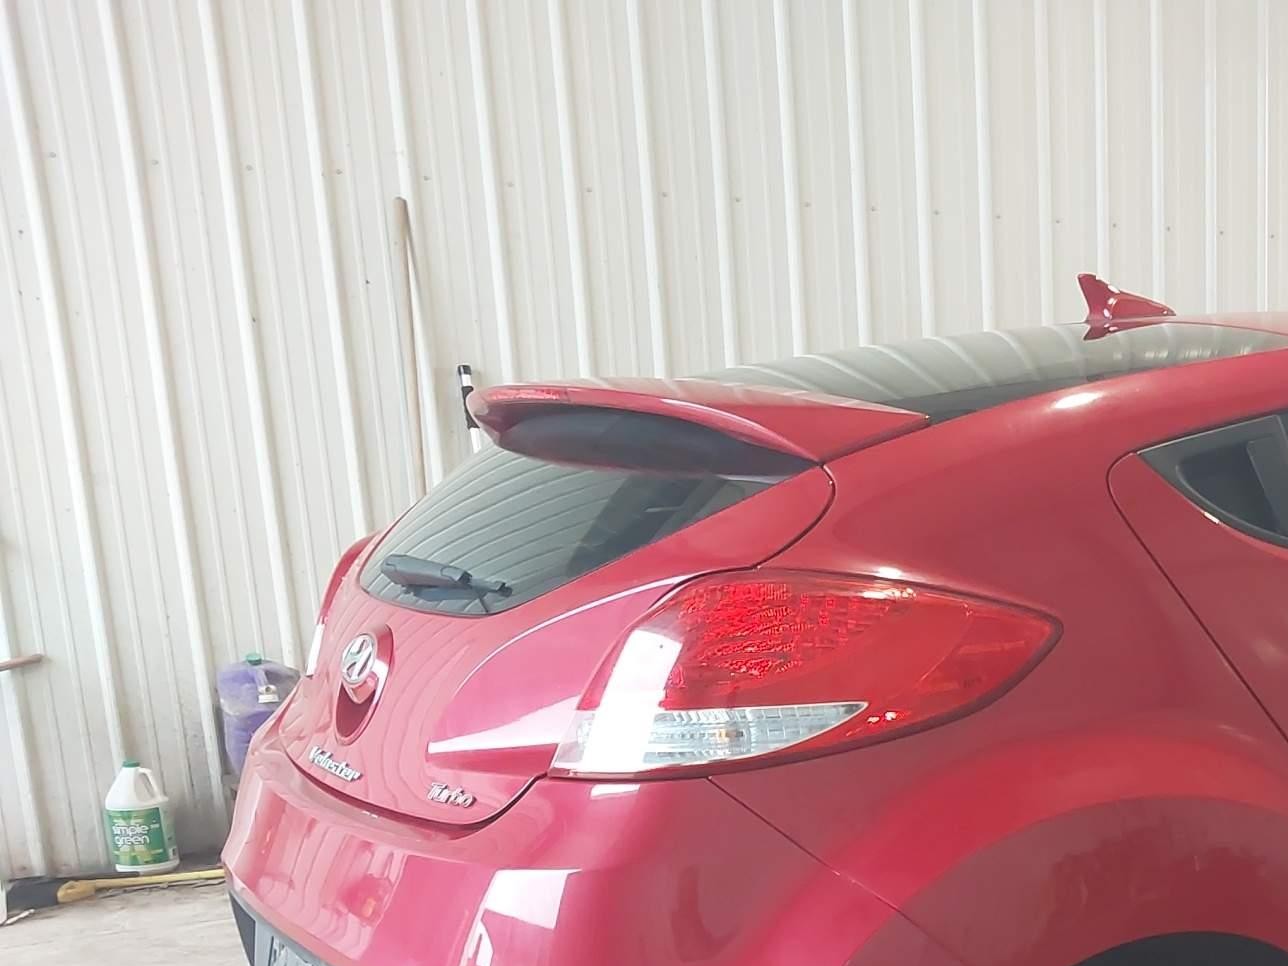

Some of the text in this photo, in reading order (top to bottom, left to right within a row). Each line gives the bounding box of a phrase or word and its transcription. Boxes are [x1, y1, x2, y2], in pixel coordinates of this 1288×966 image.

[427, 782, 477, 808] Turbo
[112, 823, 149, 836] simple
[114, 835, 150, 848] green
